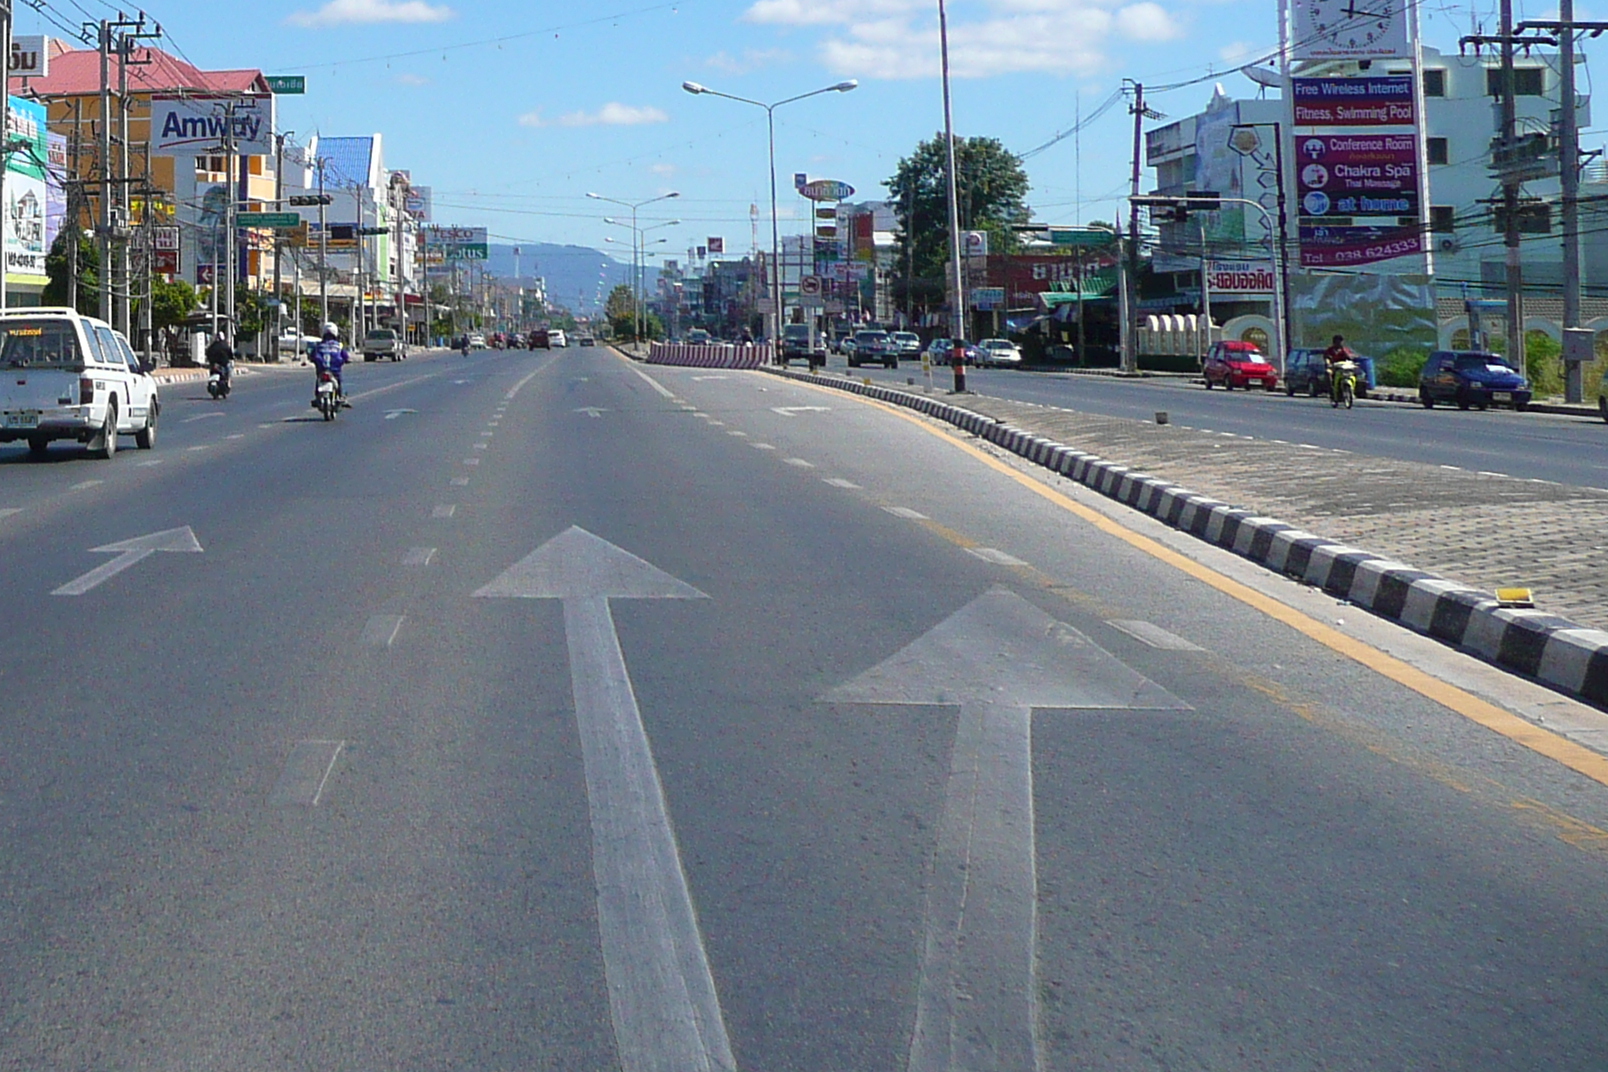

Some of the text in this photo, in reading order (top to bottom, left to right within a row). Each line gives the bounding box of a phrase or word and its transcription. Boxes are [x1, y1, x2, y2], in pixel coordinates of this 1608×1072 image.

[1295, 82, 1410, 95] Free Wireless Internet
[1295, 105, 1412, 121] Fitness, Swimming Pool
[161, 111, 262, 141] Amway
[1330, 138, 1412, 151] Conference Room
[1334, 164, 1411, 178] Chakra Spa
[1337, 196, 1410, 211] at home
[1335, 251, 1362, 261] 038
[1366, 238, 1418, 257] 624333
